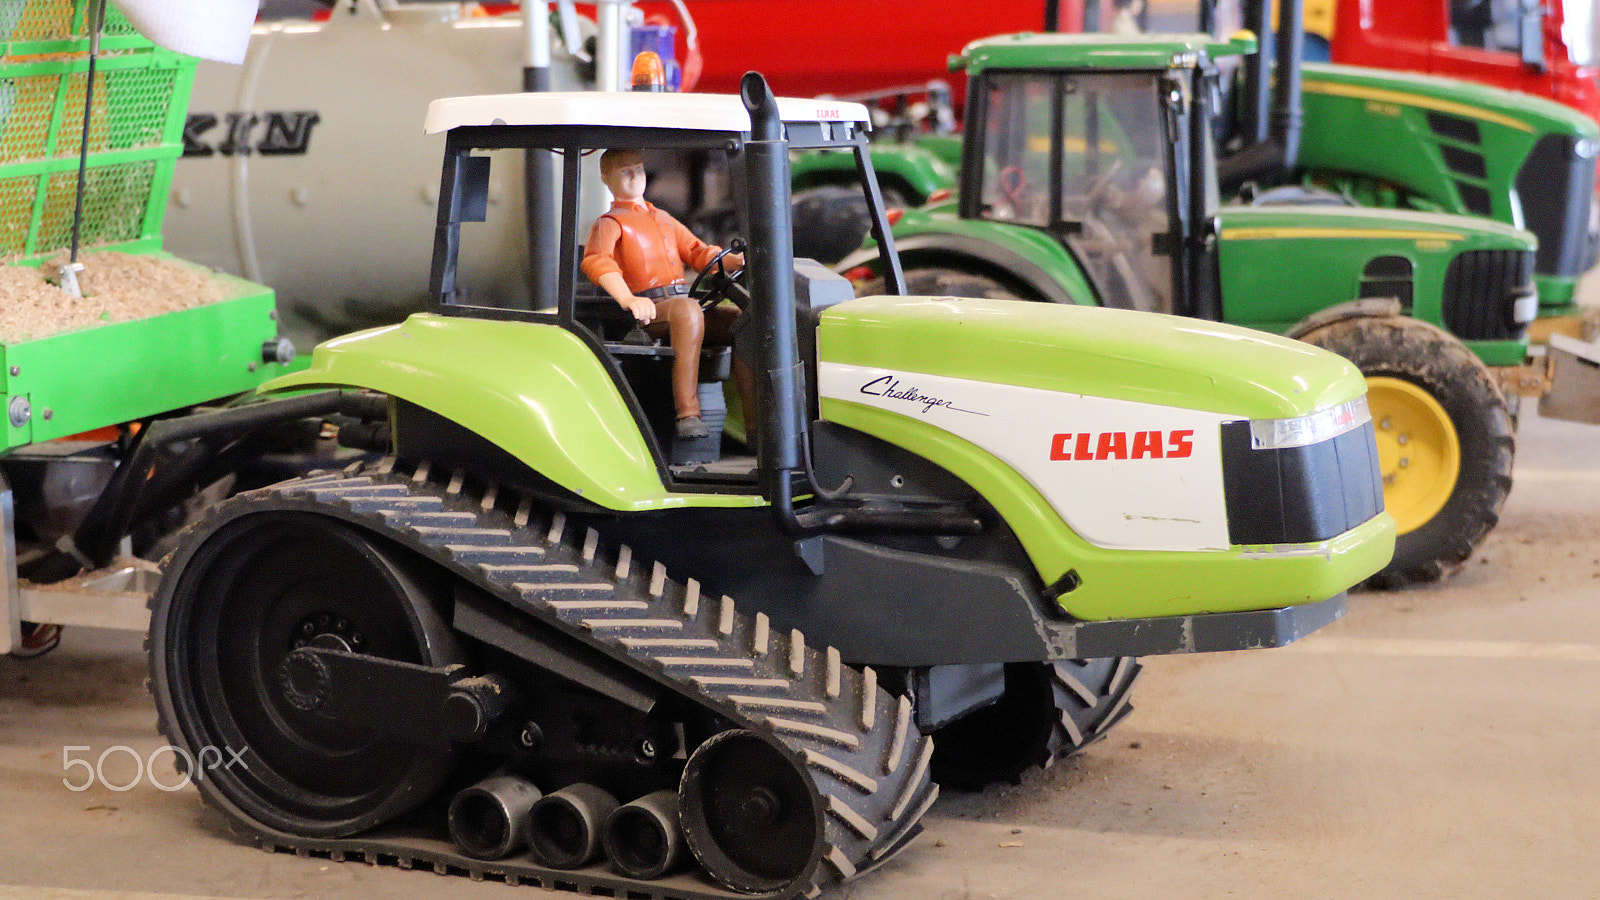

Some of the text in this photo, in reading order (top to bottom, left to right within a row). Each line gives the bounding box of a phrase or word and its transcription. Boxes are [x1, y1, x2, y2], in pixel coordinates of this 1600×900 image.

[816, 109, 840, 119] CLAAS
[860, 375, 990, 416] Challenger
[1050, 429, 1194, 461] CLAAS
